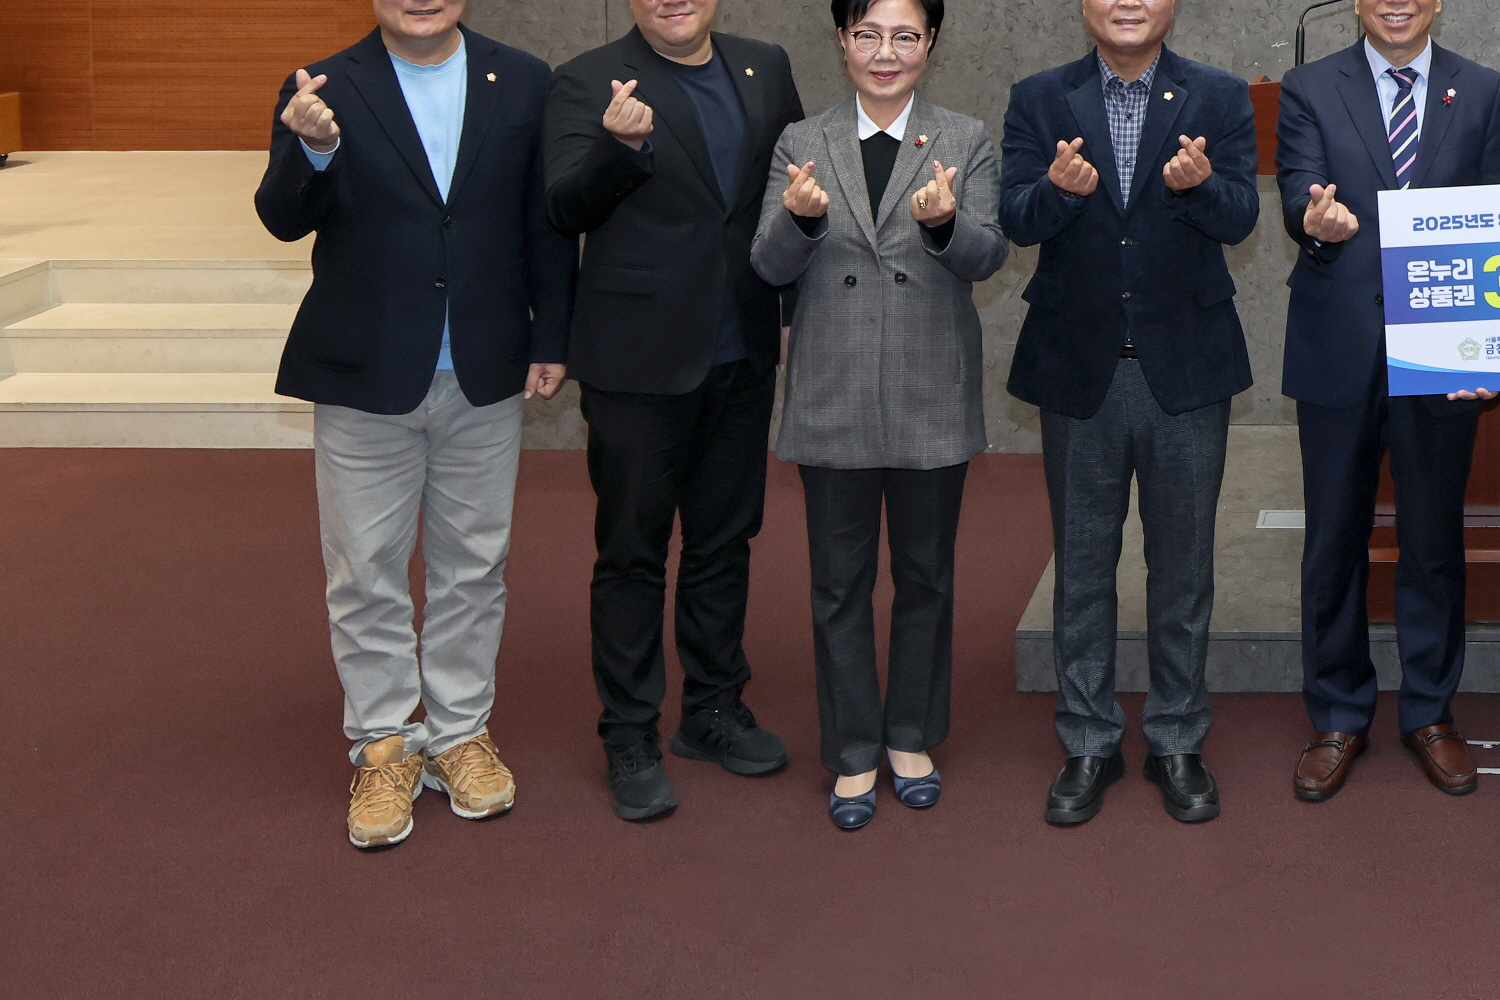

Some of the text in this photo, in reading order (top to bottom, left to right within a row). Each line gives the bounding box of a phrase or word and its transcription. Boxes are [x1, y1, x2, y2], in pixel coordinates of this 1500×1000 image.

[1412, 213, 1495, 232] 2025년도
[1406, 258, 1474, 283] 온누리
[1409, 284, 1476, 309] 상품권
